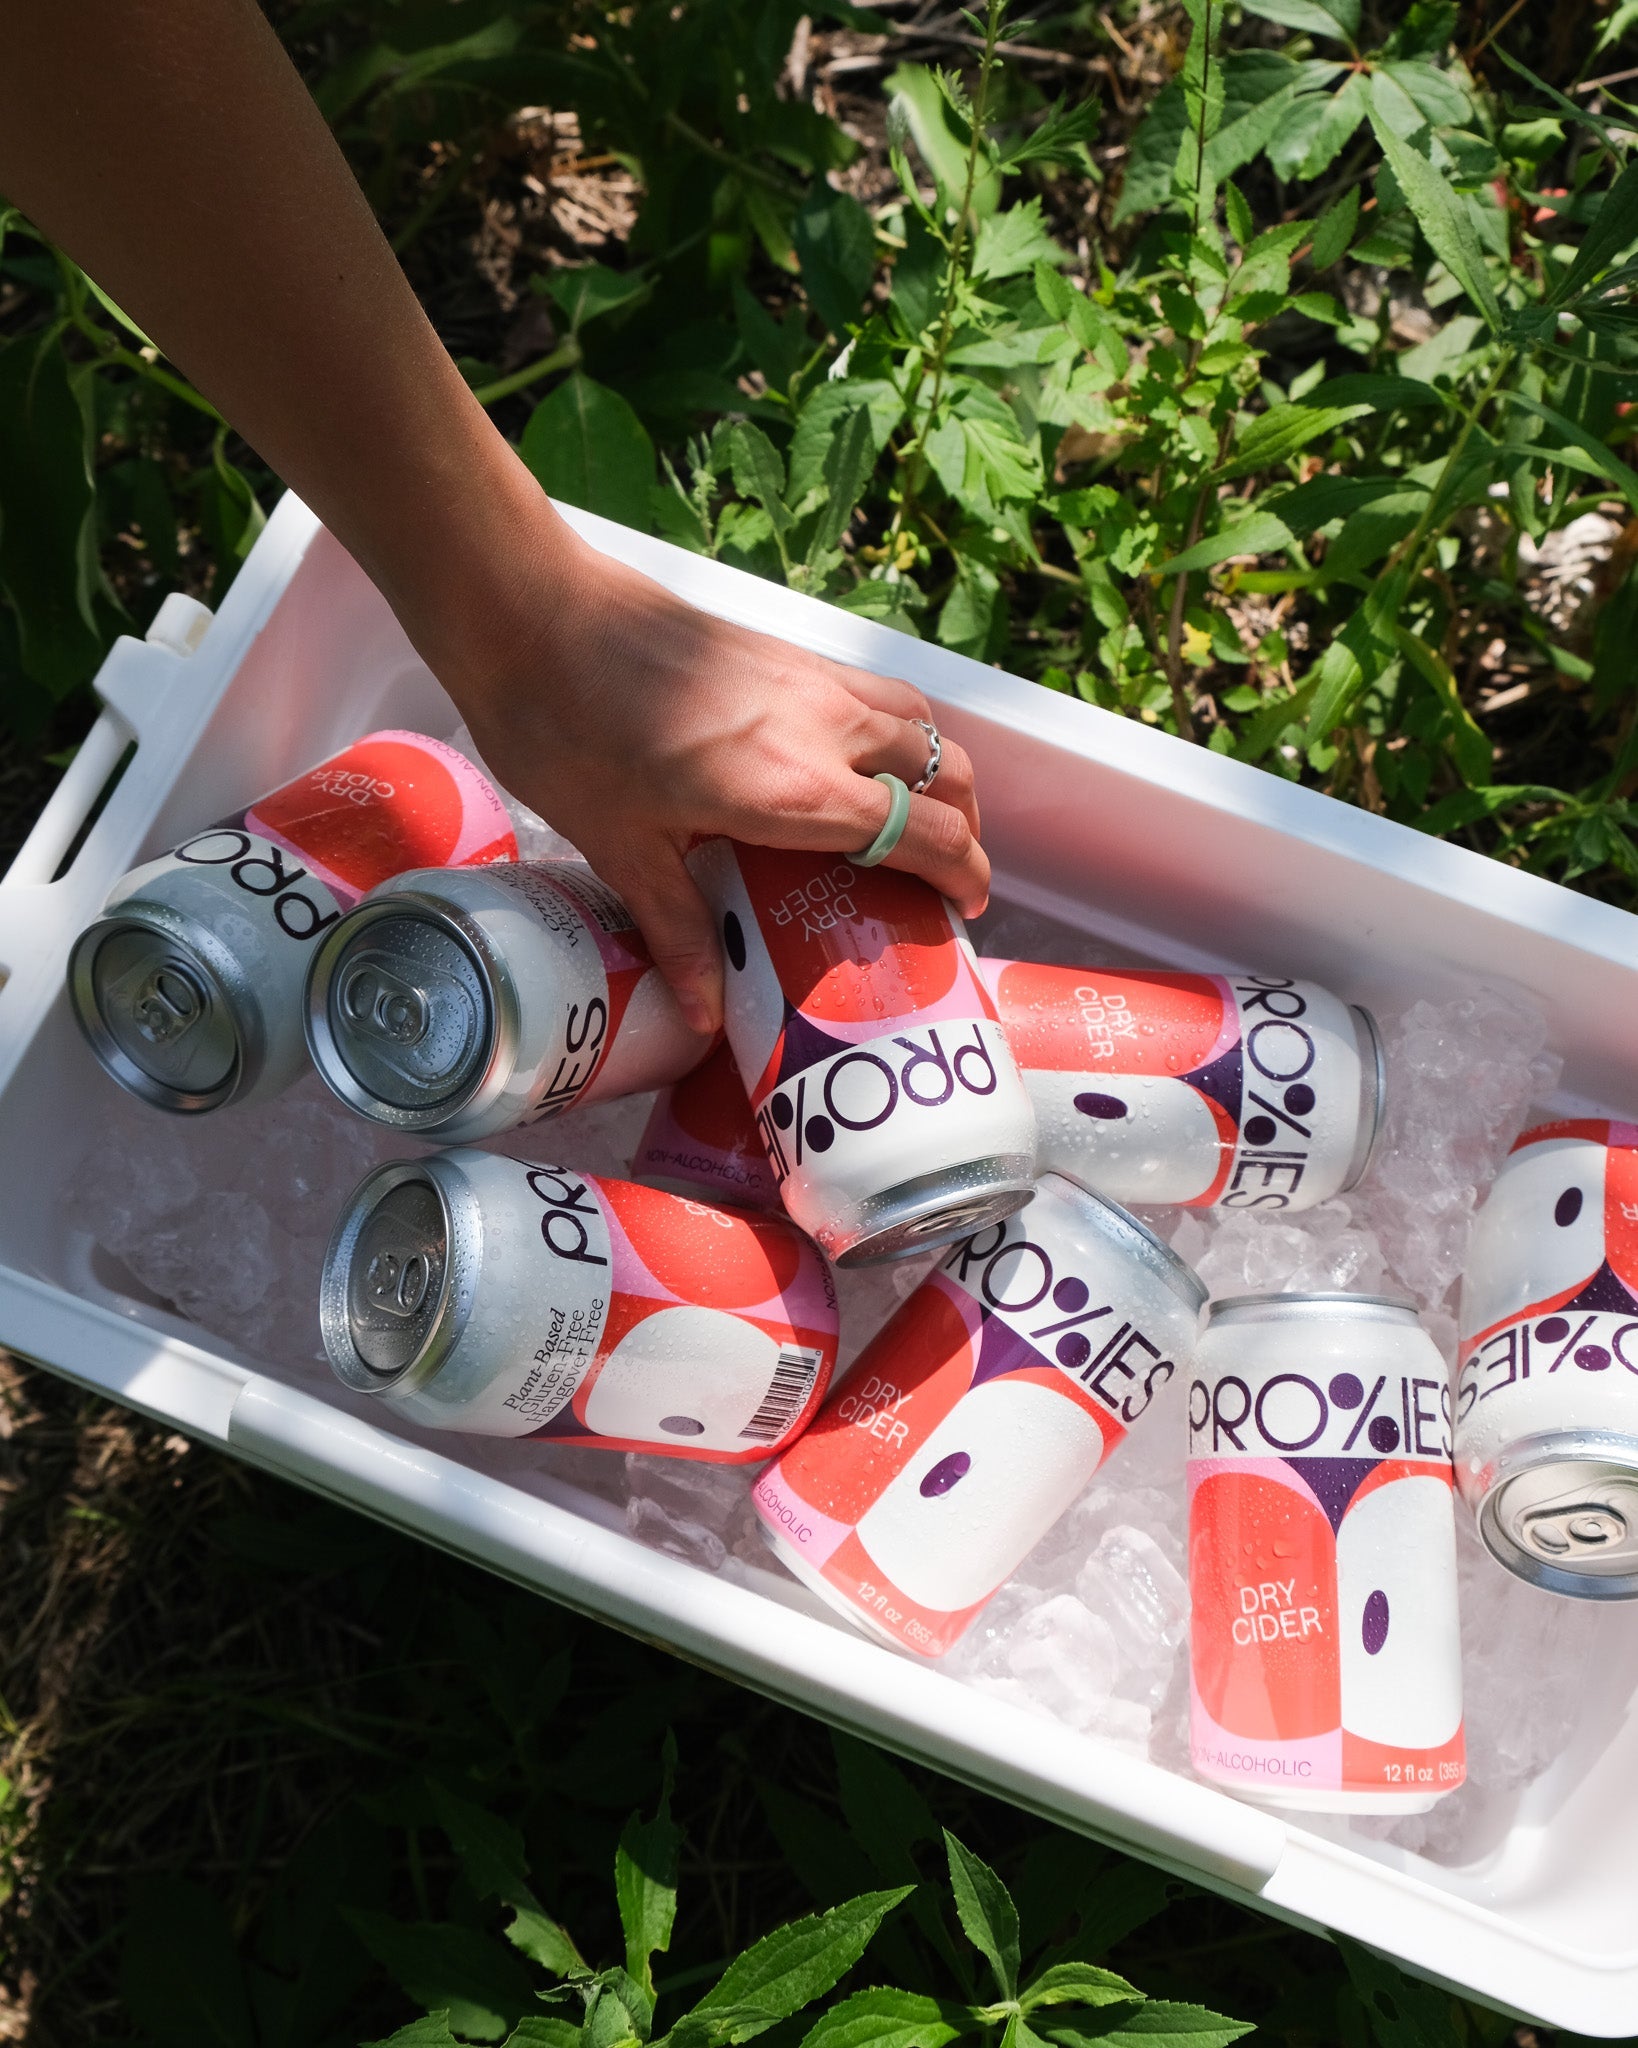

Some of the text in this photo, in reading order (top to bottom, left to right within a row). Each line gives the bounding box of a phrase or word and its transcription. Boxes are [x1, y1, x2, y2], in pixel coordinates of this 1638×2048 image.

[311, 769, 396, 799] CIDER
[311, 781, 373, 806] DRY
[545, 896, 579, 948] White
[769, 865, 857, 927] CIDER
[803, 894, 858, 943] DRY
[1073, 986, 1115, 1060] CIDER
[1101, 994, 1138, 1040] DRY
[945, 1221, 1175, 1423] RO%IES
[502, 1307, 566, 1410] Plant-Based
[518, 1309, 585, 1414] Gluten-Free
[525, 1298, 604, 1423] Hangover Free
[860, 1376, 913, 1415] DRY
[838, 1396, 910, 1450] CIDER
[857, 1581, 876, 1602] 12
[872, 1595, 888, 1611] fl
[884, 1607, 903, 1625] oz
[903, 1618, 934, 1645] (355
[1240, 1579, 1298, 1615] DRY
[1232, 1606, 1323, 1647] CIDER
[1383, 1764, 1401, 1782] 12
[1405, 1764, 1414, 1782] fl
[1419, 1768, 1434, 1782] oz
[1439, 1763, 1460, 1782] (355
